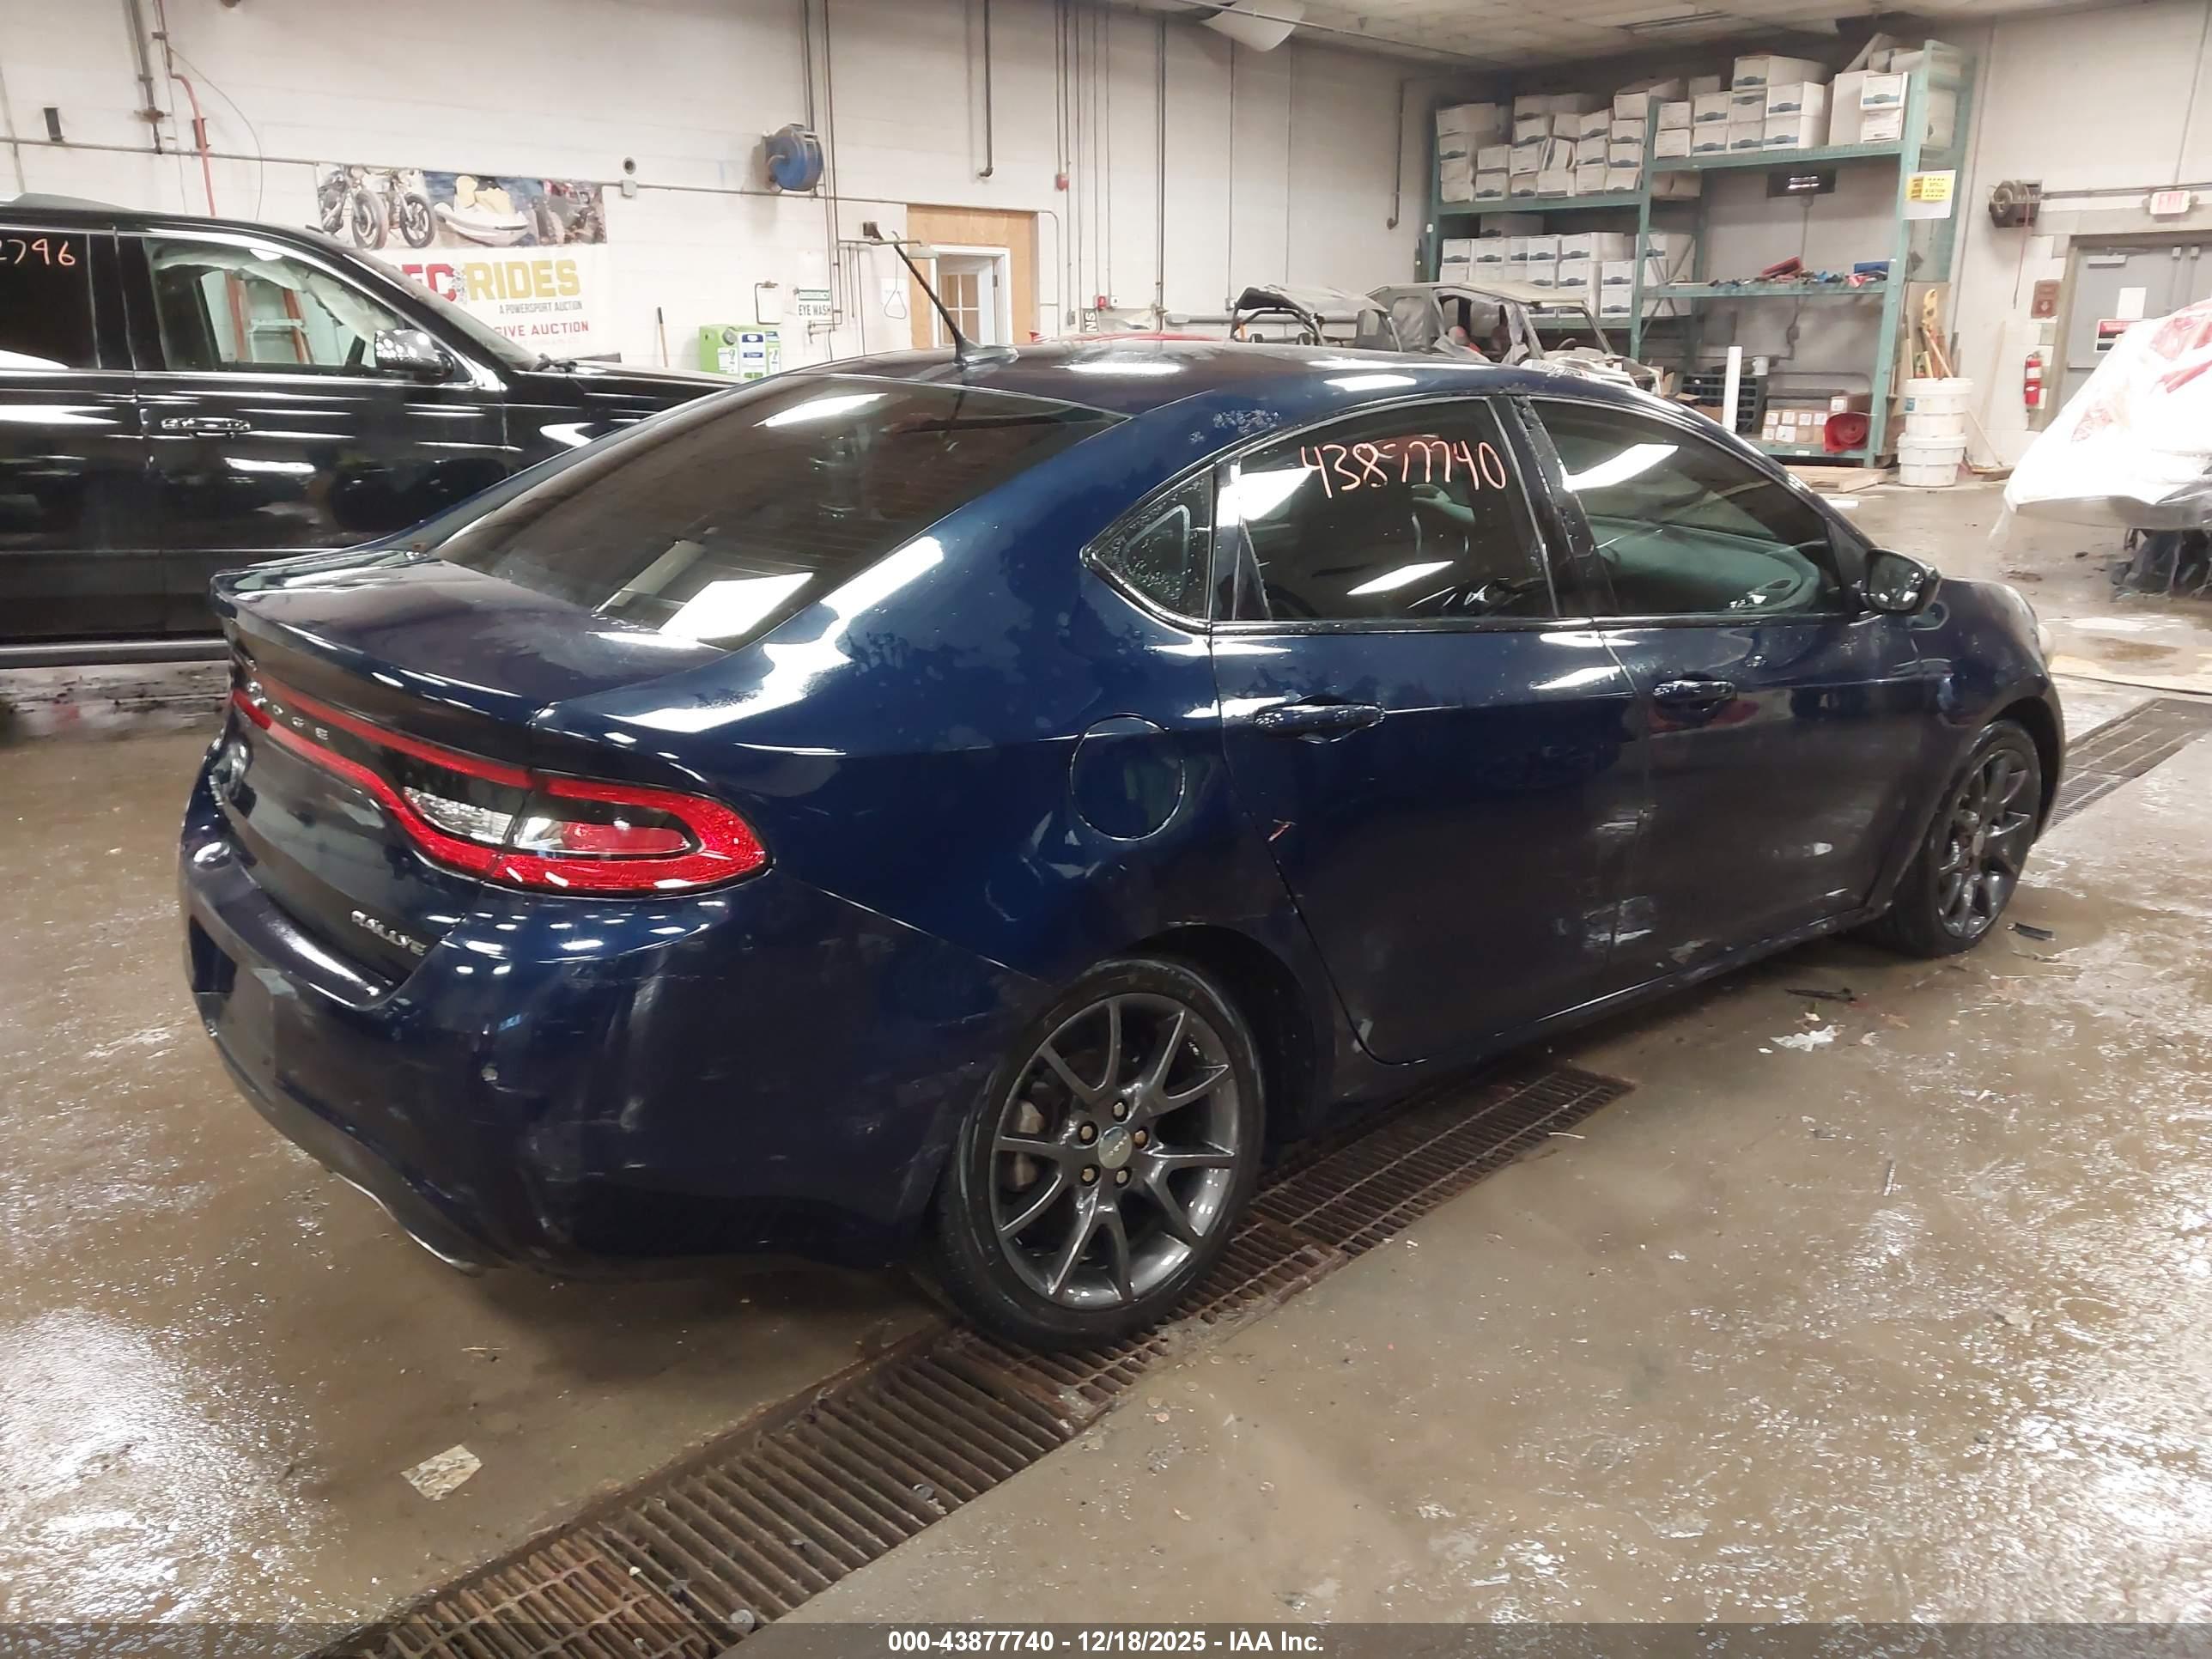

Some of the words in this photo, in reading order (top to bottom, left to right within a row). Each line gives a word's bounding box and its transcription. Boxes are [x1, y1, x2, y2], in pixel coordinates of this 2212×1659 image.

[465, 259, 580, 301] RIDES
[499, 304, 504, 314] A
[505, 301, 551, 314] POWERSPORT
[555, 301, 583, 312] AUCTION
[799, 304, 811, 316] EYE
[812, 304, 832, 316] WASH
[531, 321, 589, 336] AUCTION
